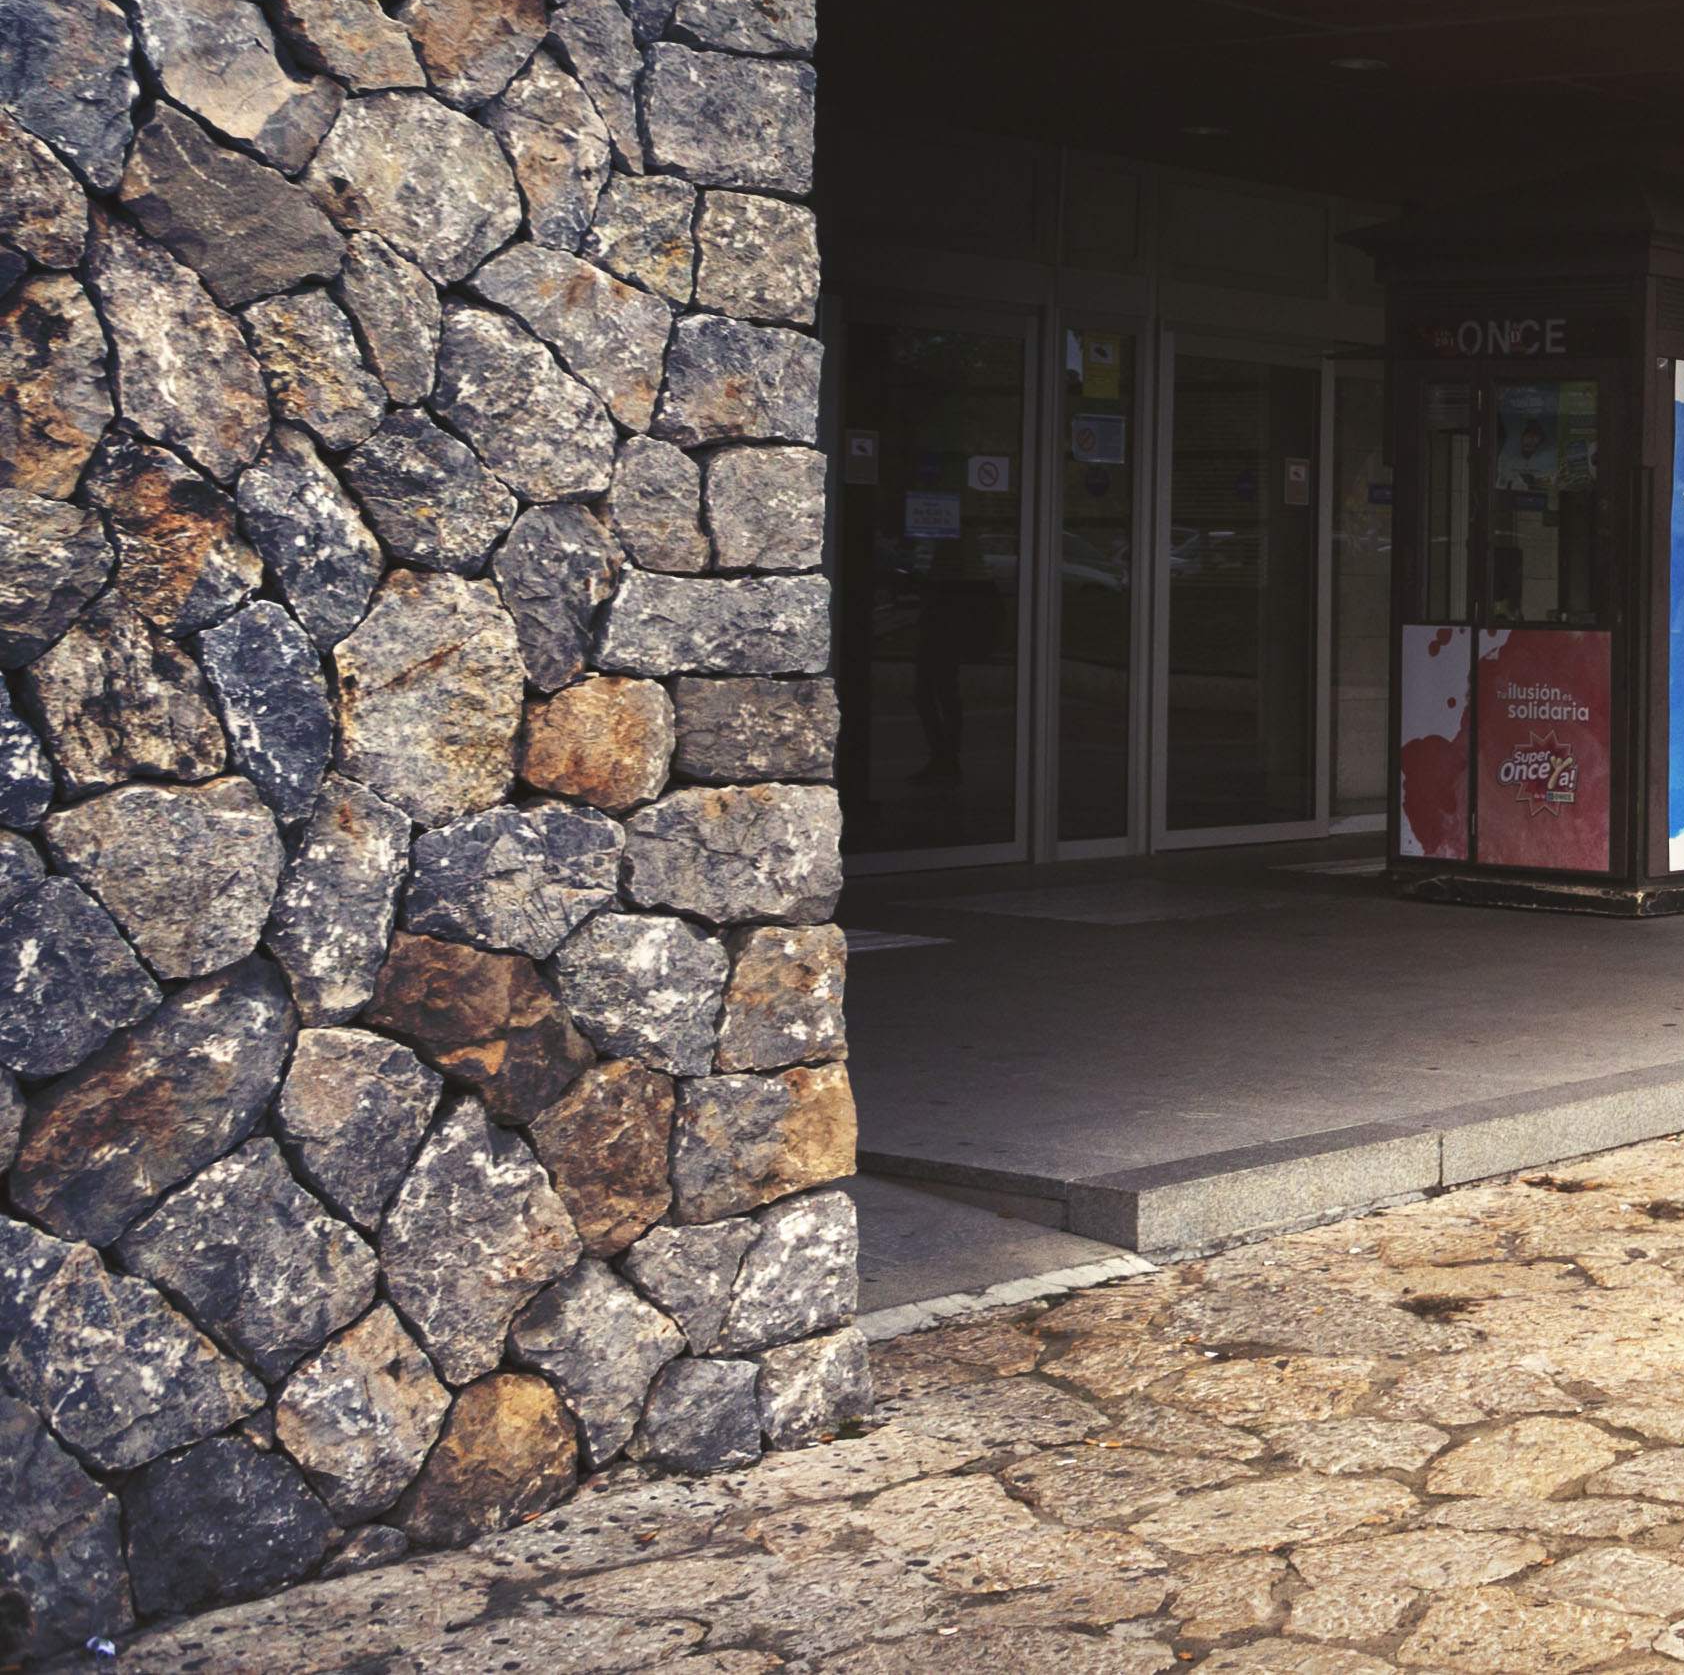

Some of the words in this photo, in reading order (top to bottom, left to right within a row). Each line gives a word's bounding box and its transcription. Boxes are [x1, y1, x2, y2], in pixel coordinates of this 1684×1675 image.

[1456, 317, 1568, 356] ONCE
[1507, 681, 1561, 701] ilusión
[1507, 701, 1590, 722] solidaria
[1514, 751, 1551, 764] Super
[1499, 761, 1551, 783] Once
